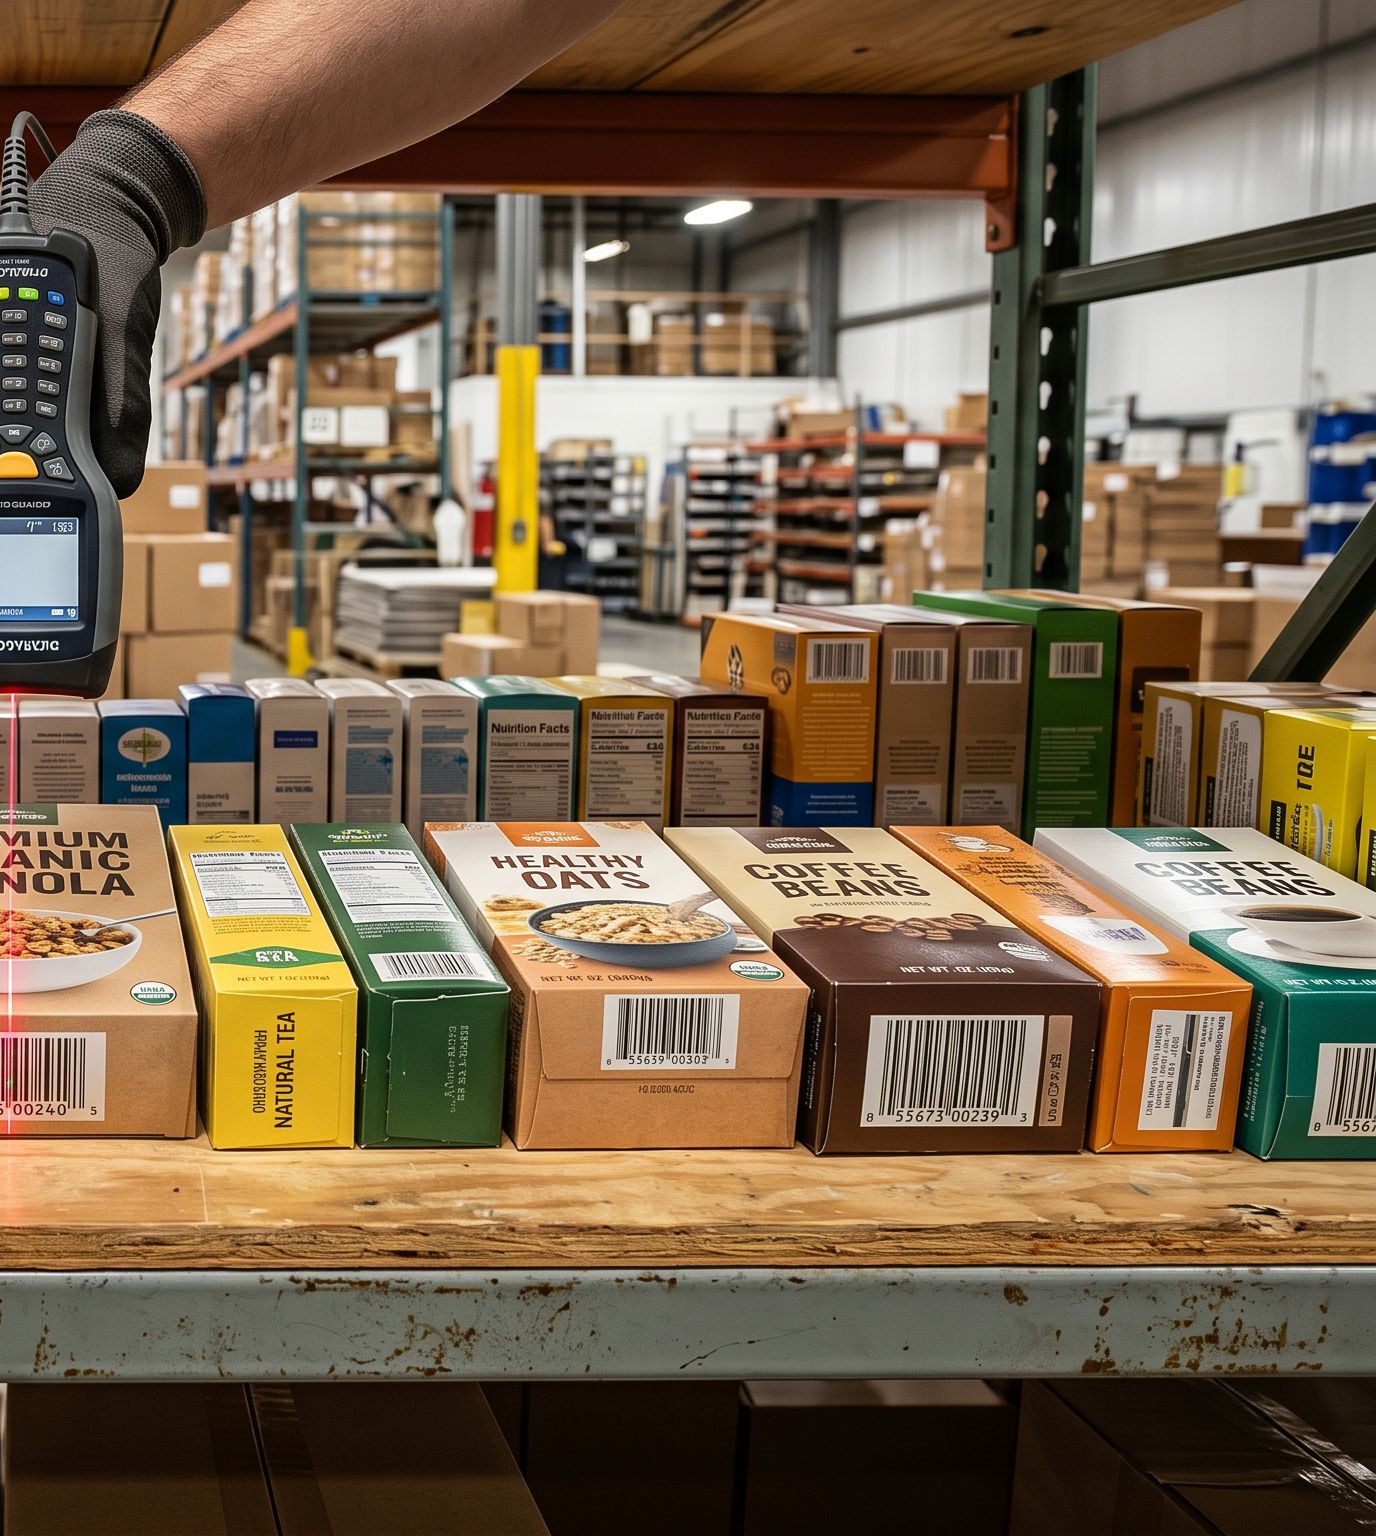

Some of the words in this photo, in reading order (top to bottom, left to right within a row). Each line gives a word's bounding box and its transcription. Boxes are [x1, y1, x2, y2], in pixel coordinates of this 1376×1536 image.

[490, 854, 644, 870] HEALTHY
[742, 862, 910, 880] COFFEE
[1134, 861, 1314, 878] COFFEE
[520, 870, 651, 890] OATS
[1170, 879, 1336, 897] BEANS
[770, 880, 932, 899] BEANS
[277, 1011, 296, 1041] TEA
[274, 1049, 295, 1129] NATURAL
[13, 1103, 67, 1116] 00240
[90, 1106, 98, 1115] 5
[866, 1111, 874, 1122] 8
[895, 1109, 944, 1122] 55673
[951, 1109, 1000, 1122] 00239
[1020, 1111, 1028, 1122] 3
[1313, 1122, 1321, 1132] 8
